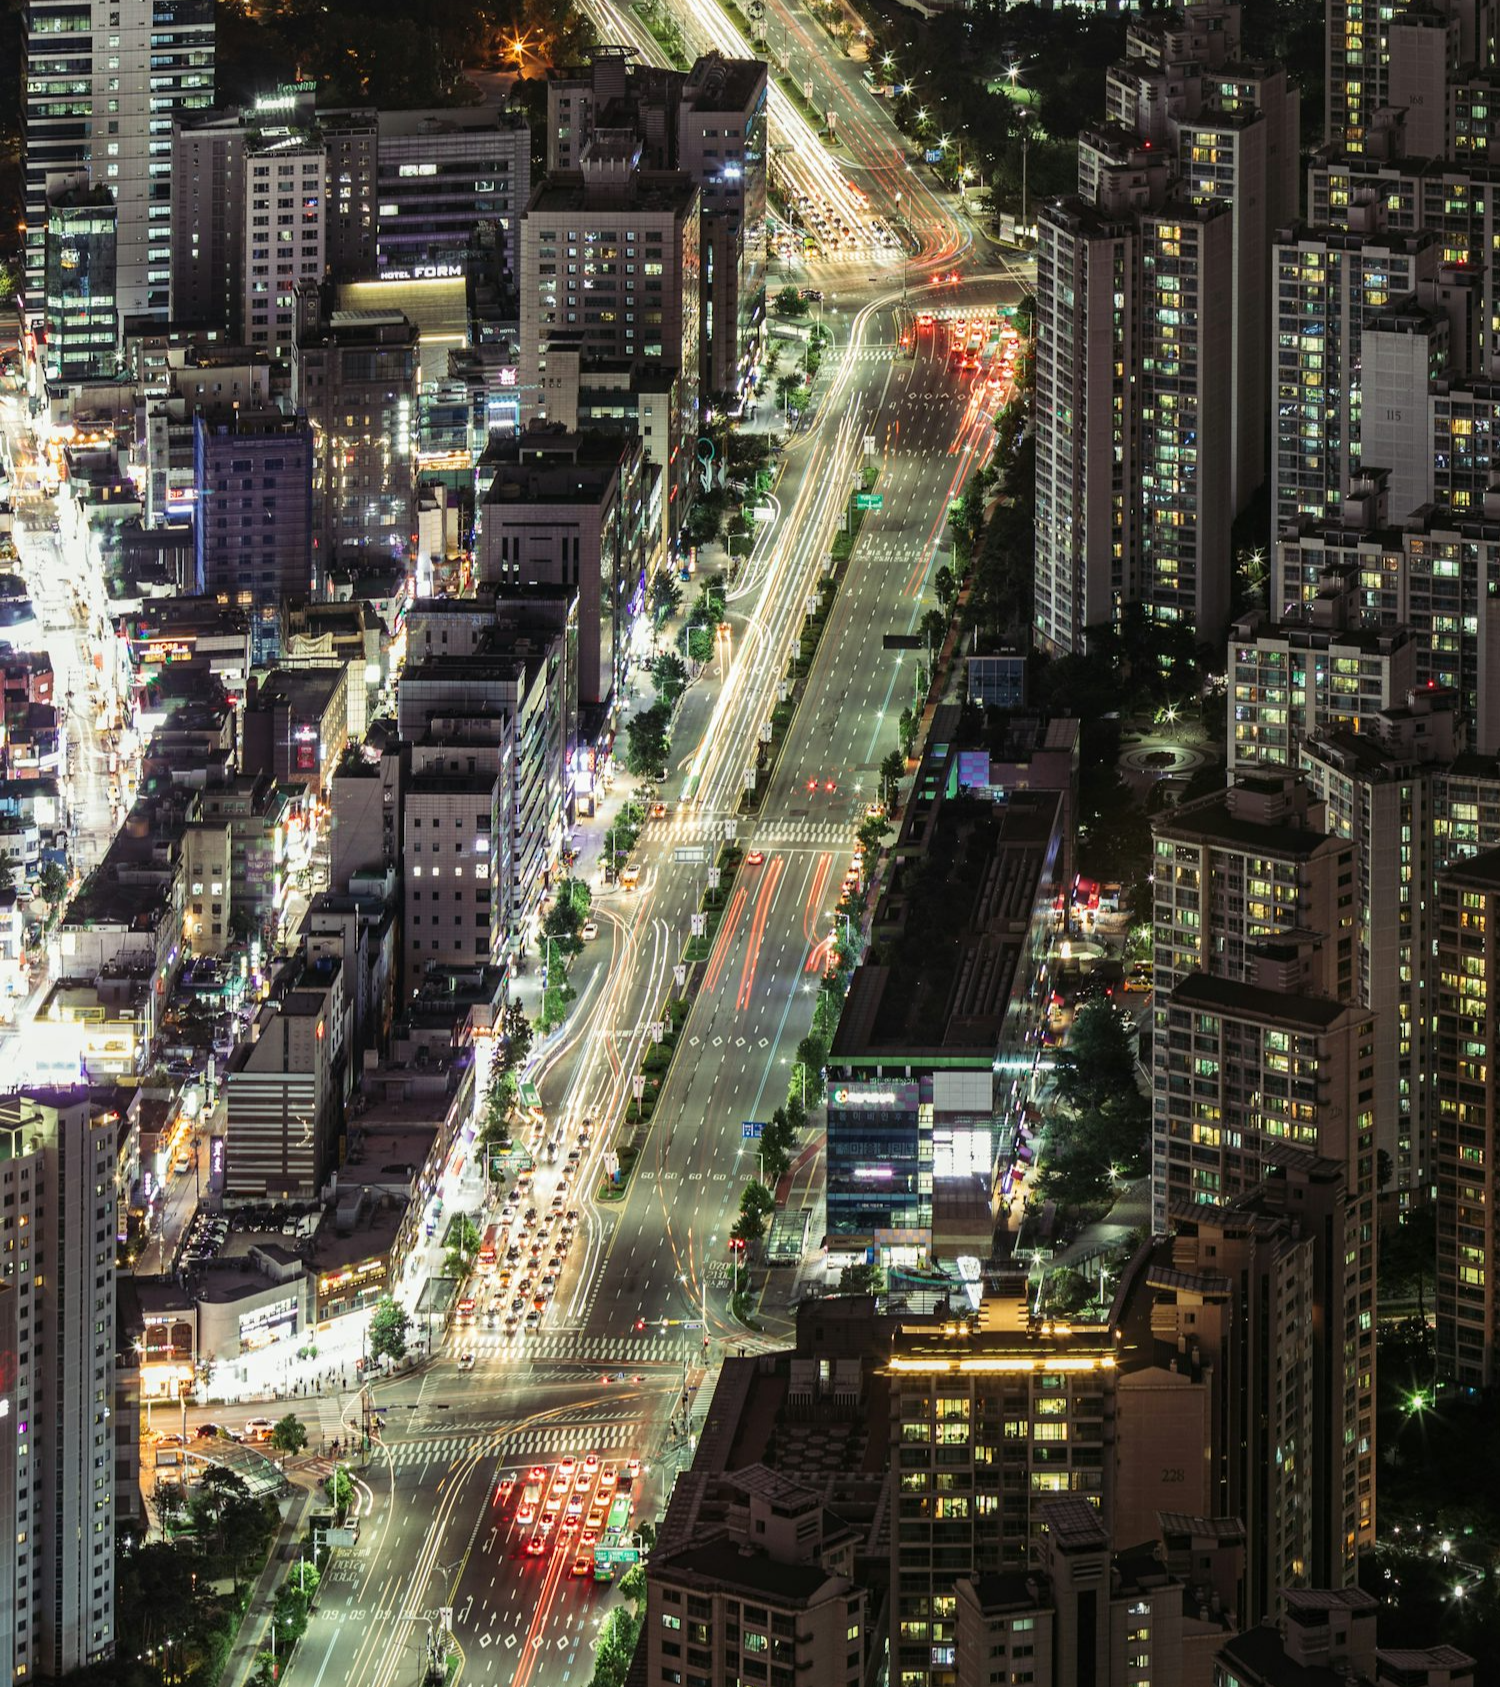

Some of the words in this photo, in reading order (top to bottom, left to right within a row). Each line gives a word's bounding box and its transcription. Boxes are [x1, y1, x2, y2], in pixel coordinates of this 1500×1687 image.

[381, 271, 410, 280] HOTEL
[415, 265, 462, 278] FORM
[482, 327, 493, 335] We
[1386, 410, 1402, 420] 115
[641, 1171, 654, 1179] 60
[664, 1171, 678, 1179] 60
[688, 1172, 702, 1180] 60
[713, 1173, 727, 1181] 60
[1161, 1469, 1185, 1483] 228
[322, 1609, 339, 1620] 60
[349, 1609, 366, 1620] 60
